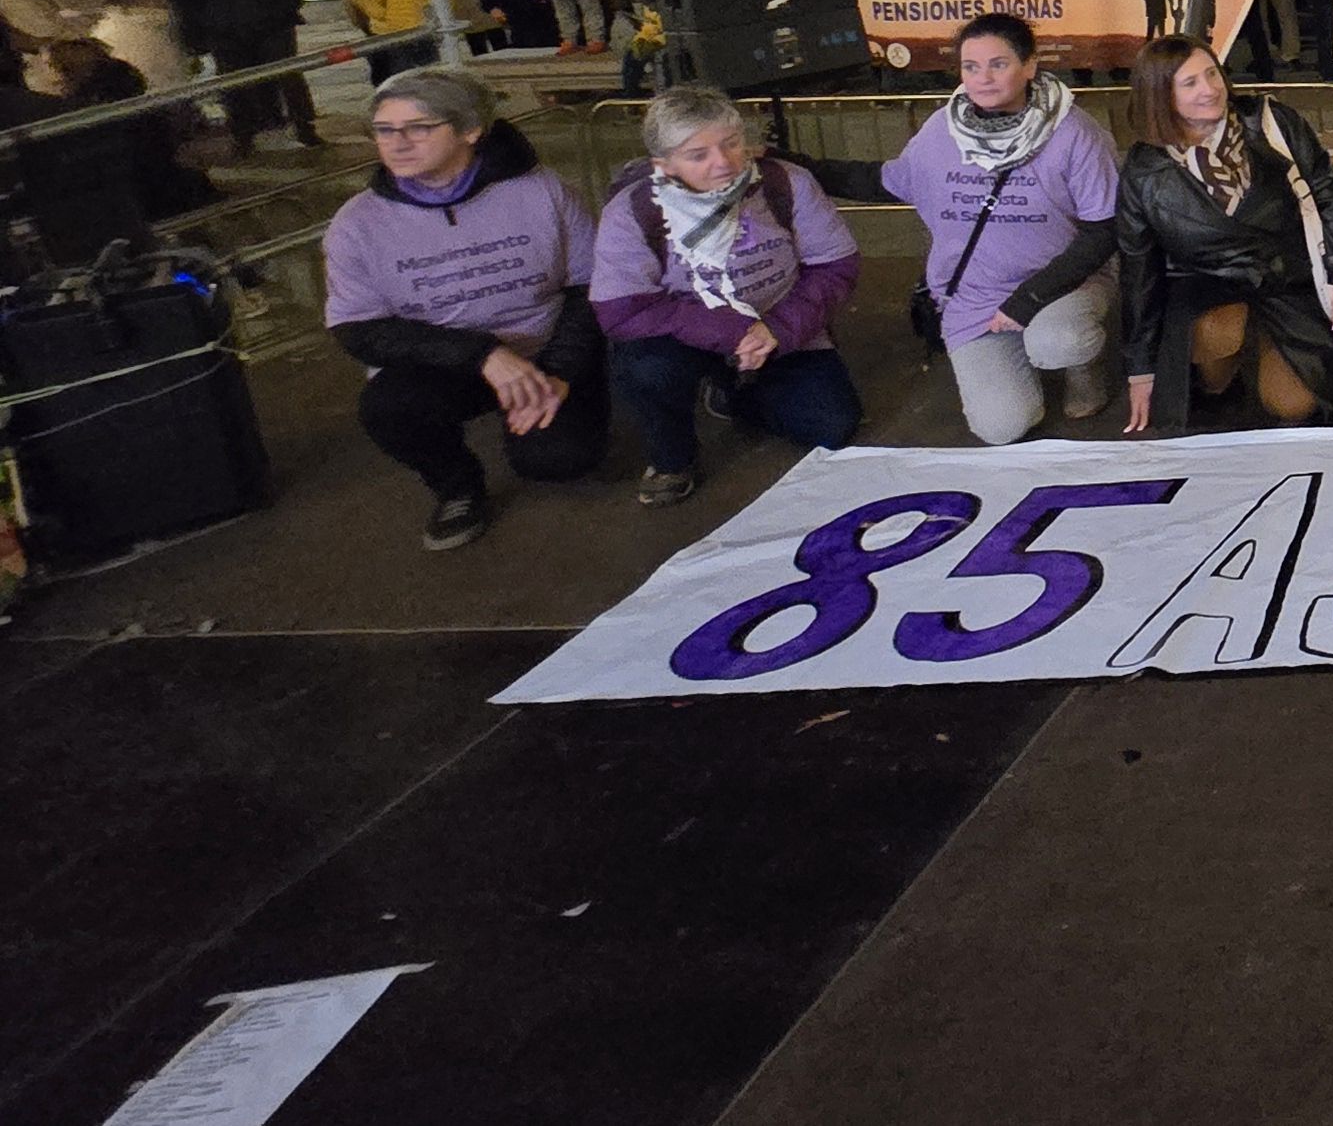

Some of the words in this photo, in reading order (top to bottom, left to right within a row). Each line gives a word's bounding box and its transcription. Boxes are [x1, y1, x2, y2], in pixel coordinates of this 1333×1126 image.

[872, 0, 985, 21] PENSIONES
[993, 0, 1064, 19] DIGNAS
[940, 209, 958, 221] de
[397, 234, 532, 273] Movimiento
[412, 257, 525, 291] Feminista
[430, 272, 549, 310] Salamanca
[668, 476, 1186, 682] 85
